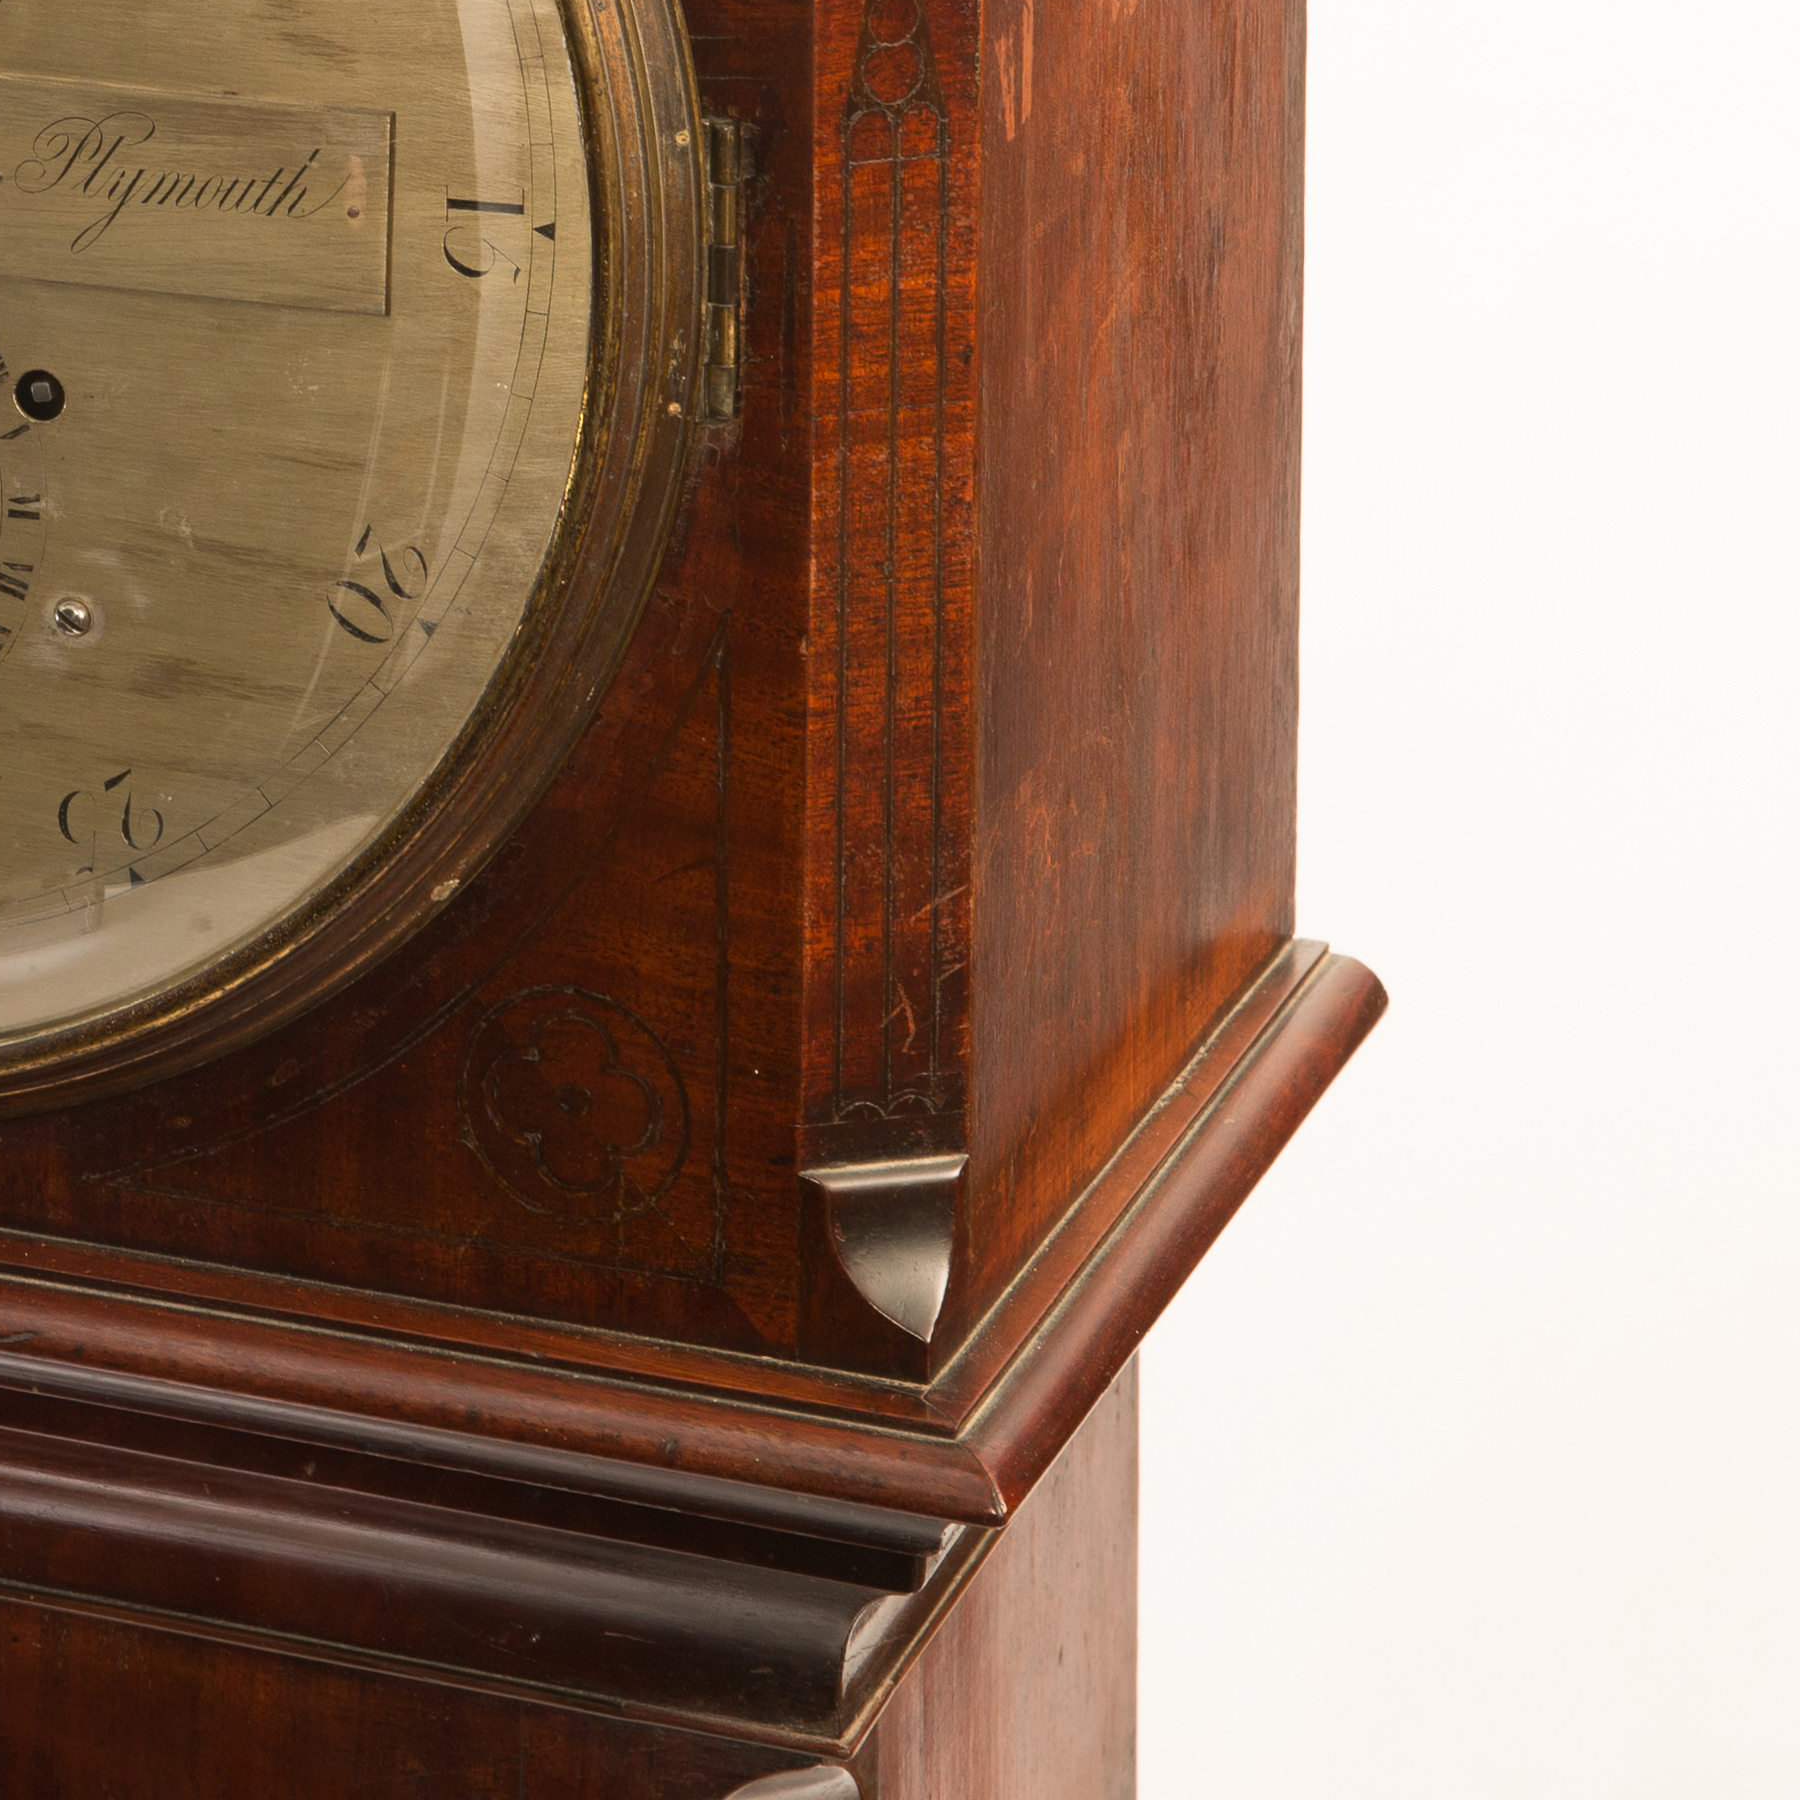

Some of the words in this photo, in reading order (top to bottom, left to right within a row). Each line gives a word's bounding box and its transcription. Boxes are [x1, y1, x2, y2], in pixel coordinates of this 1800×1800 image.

[14, 112, 353, 253] Plymouth
[443, 187, 526, 284] 15
[327, 525, 428, 644] 20
[58, 770, 164, 875] 25
